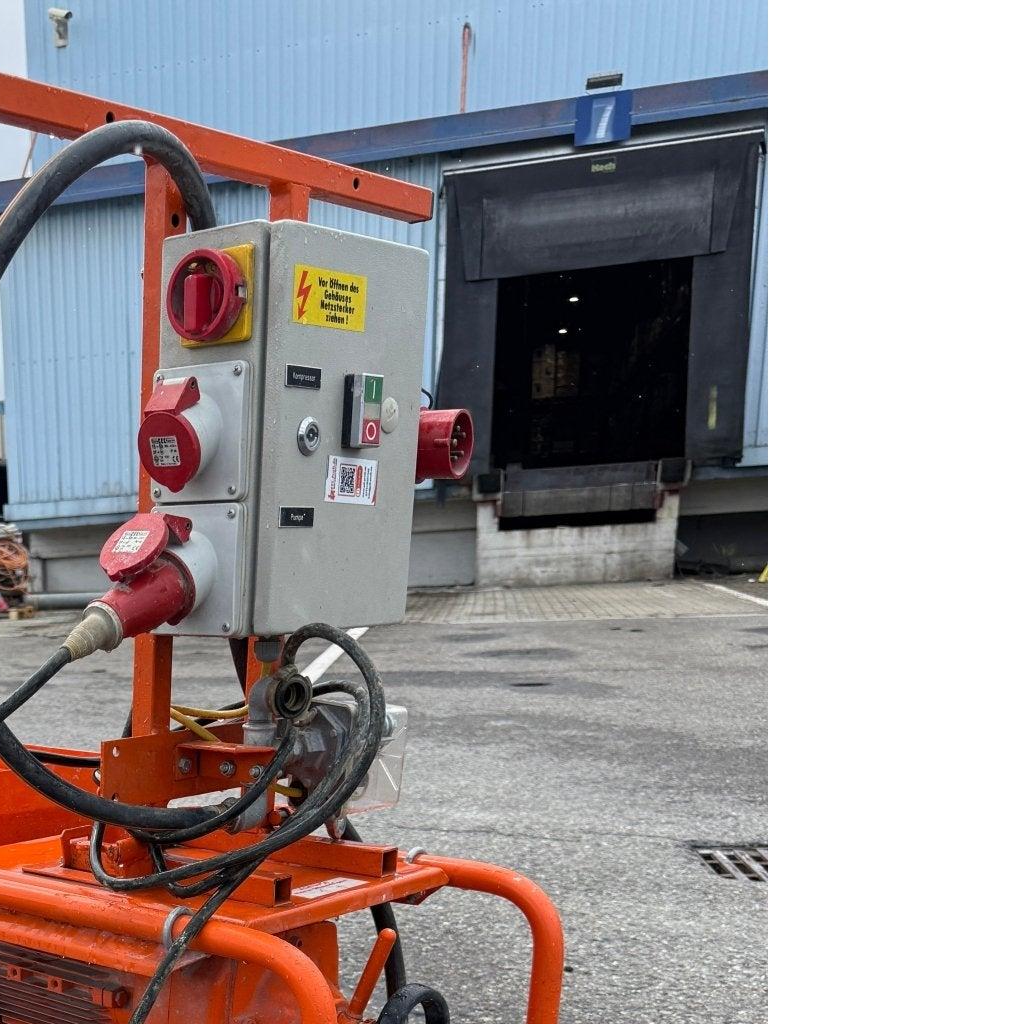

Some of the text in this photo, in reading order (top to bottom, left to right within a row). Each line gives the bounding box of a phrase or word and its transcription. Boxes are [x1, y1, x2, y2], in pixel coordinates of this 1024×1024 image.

[591, 95, 617, 139] 7
[319, 276, 360, 294] Vor Öffnen des
[324, 289, 352, 304] Gehäuses
[326, 311, 345, 325] ziehen
[290, 513, 305, 523] Pumpe
